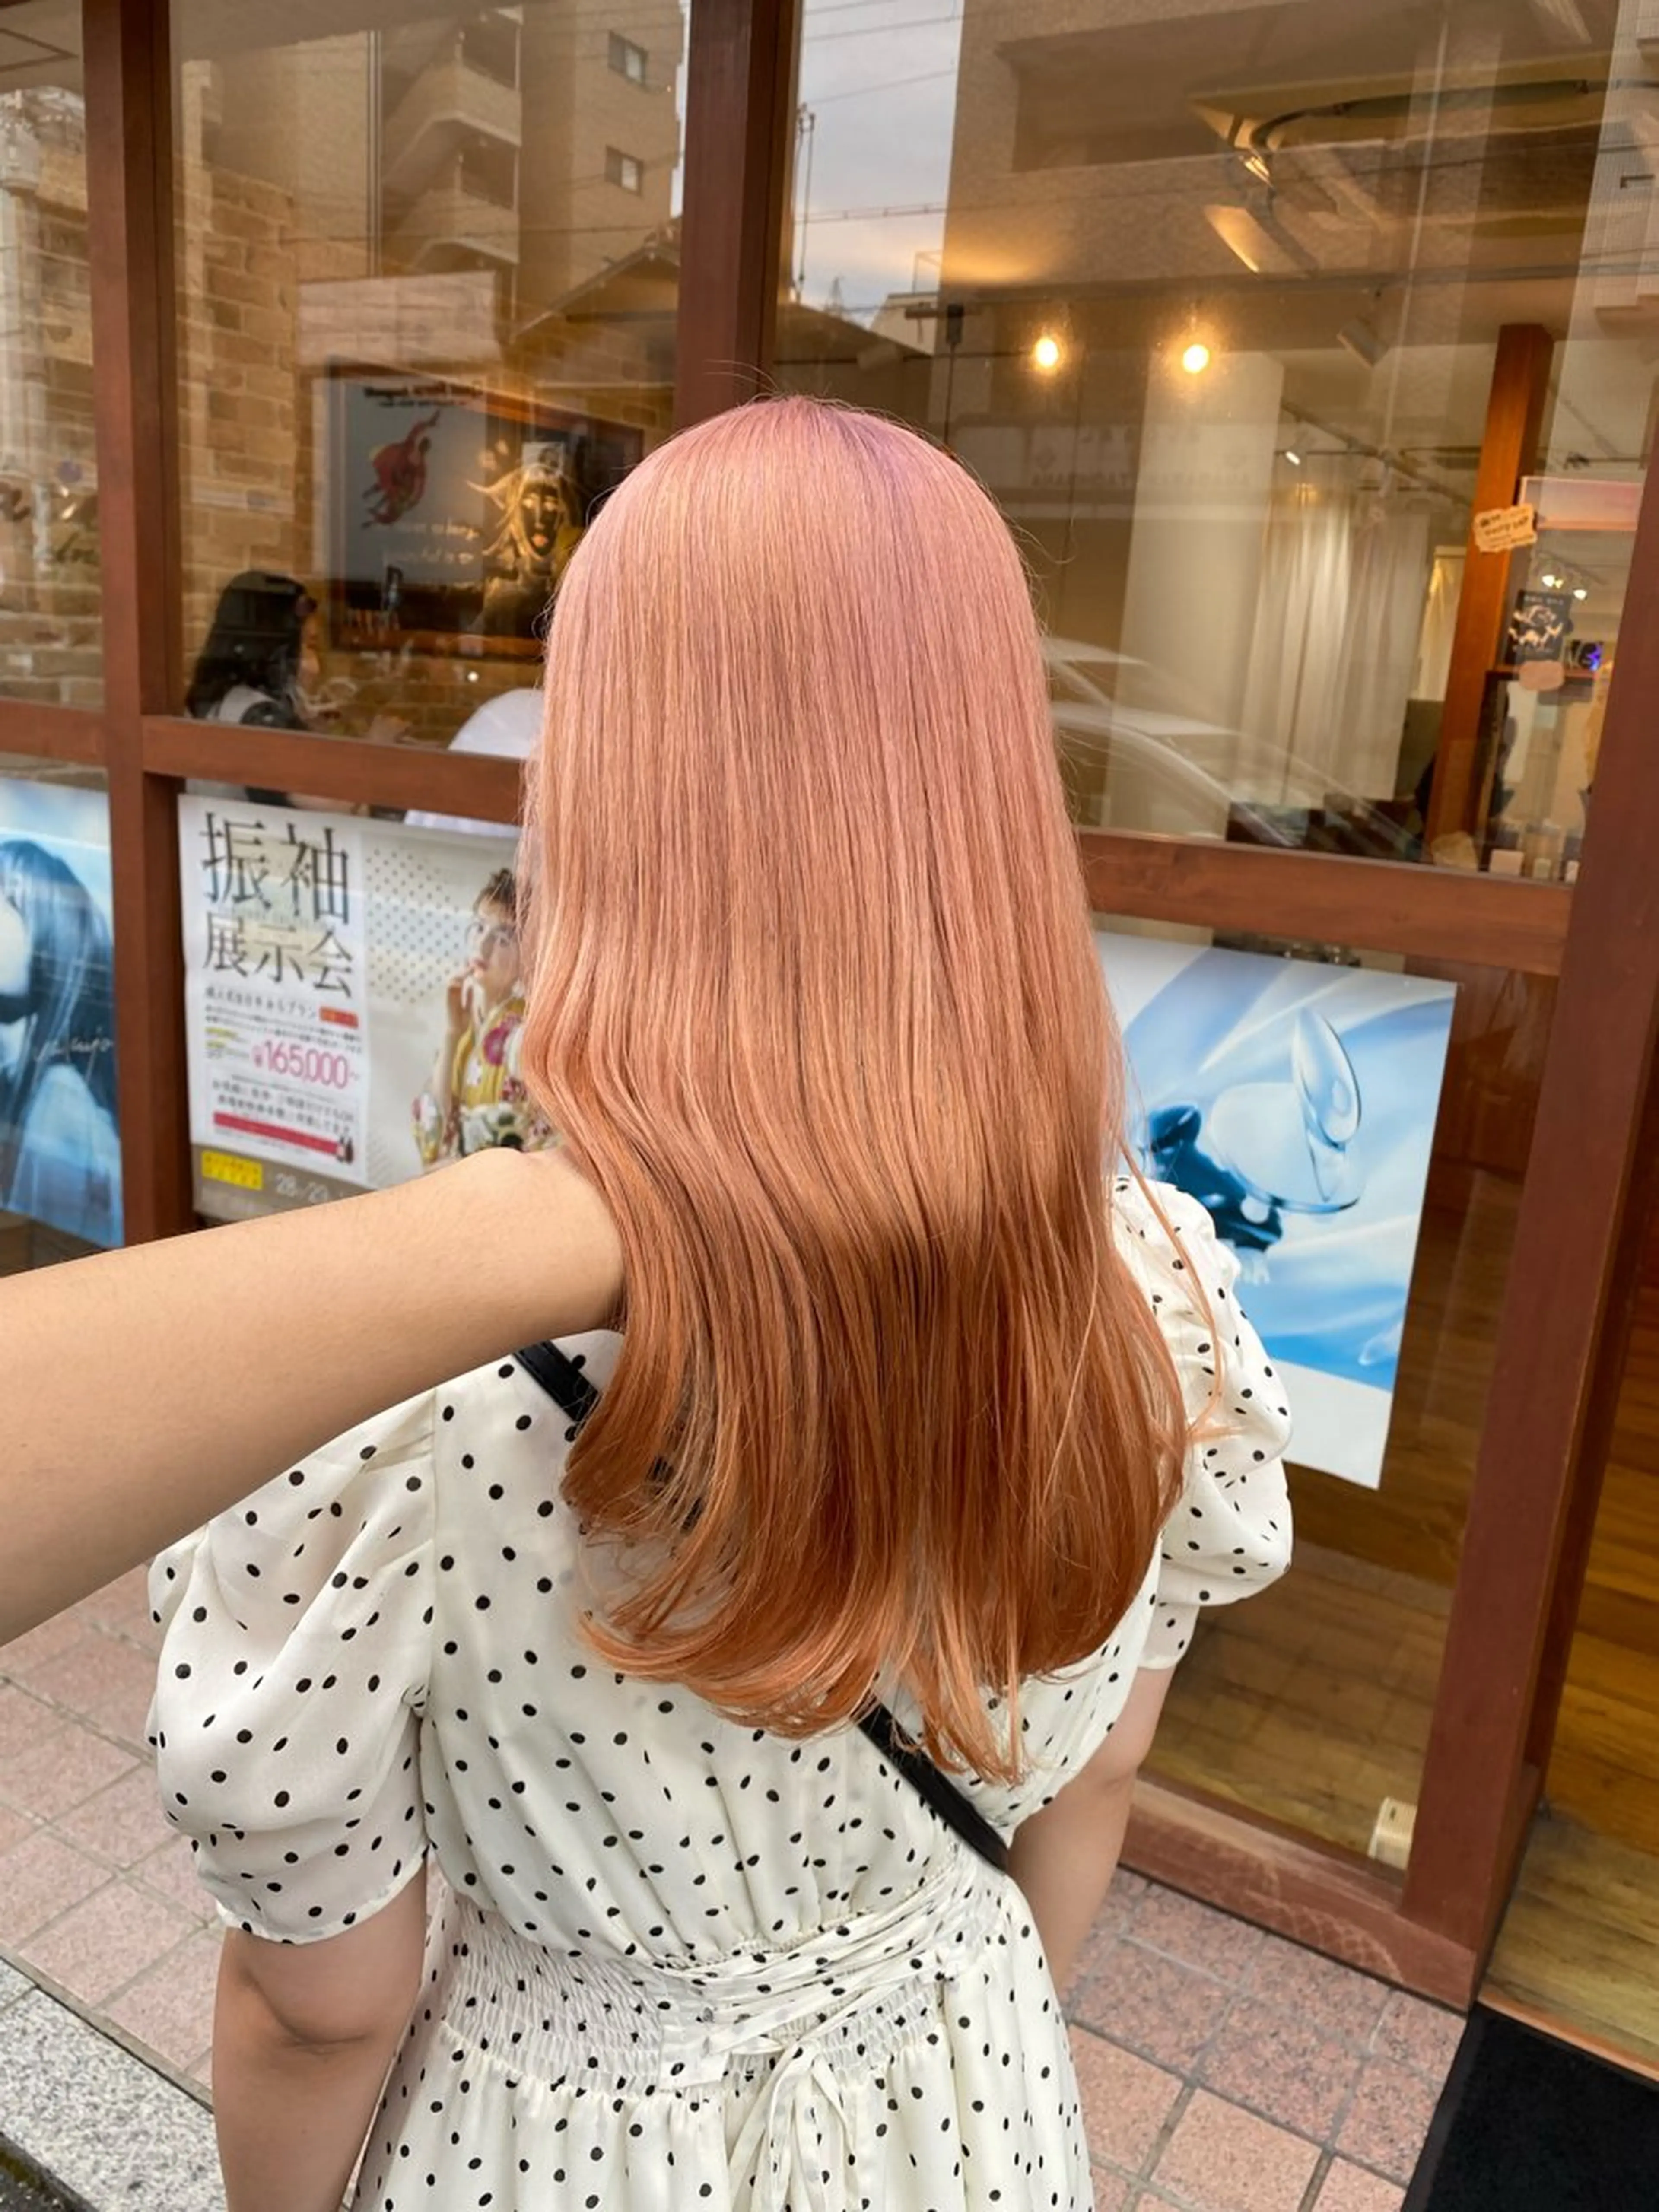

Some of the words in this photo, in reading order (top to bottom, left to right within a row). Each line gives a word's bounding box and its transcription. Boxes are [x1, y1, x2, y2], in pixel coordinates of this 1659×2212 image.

[199, 812, 349, 925] 振袖
[203, 912, 353, 998] 展示会
